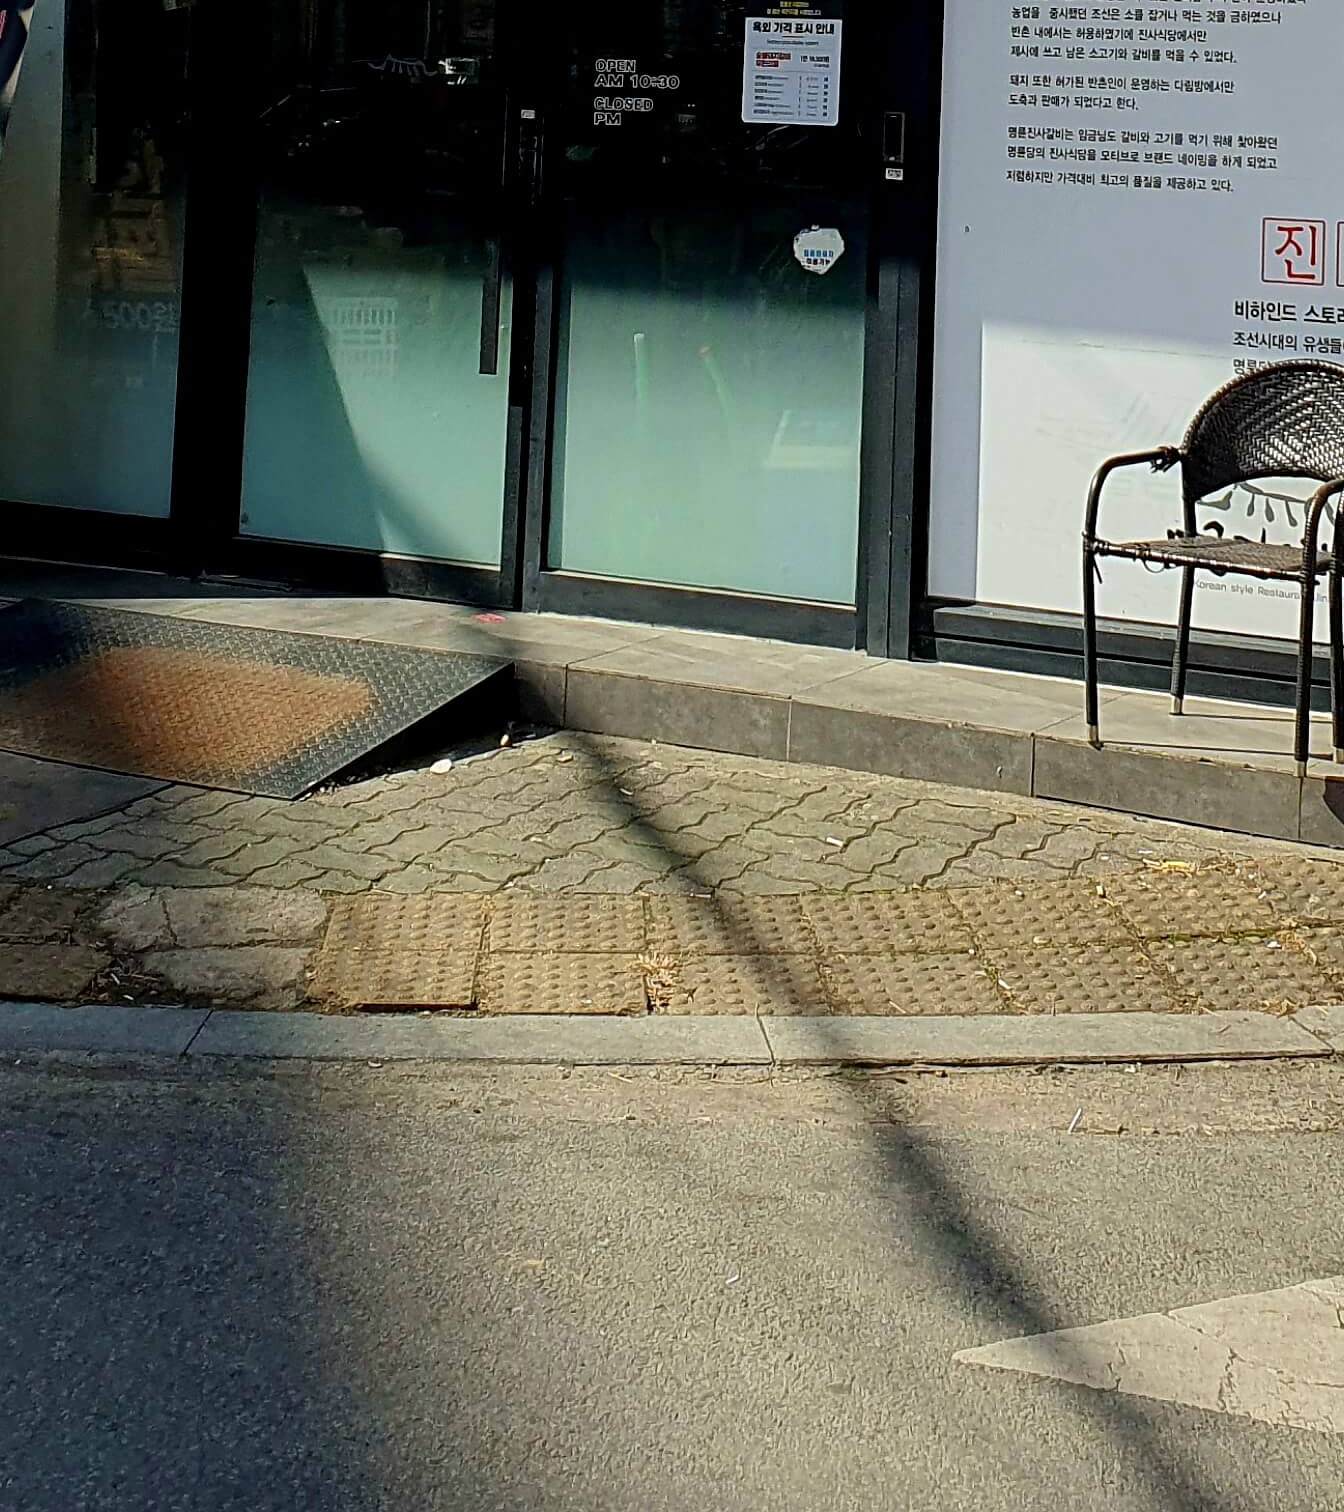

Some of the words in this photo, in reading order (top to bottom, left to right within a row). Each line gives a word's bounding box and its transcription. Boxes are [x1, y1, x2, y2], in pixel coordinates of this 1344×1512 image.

[595, 59, 636, 74] OPEN
[594, 74, 624, 88] AM
[594, 97, 653, 112] CLOSED
[594, 112, 621, 126] PM
[1234, 300, 1297, 322] 비하인드
[1232, 330, 1298, 352] 조선시대의
[1231, 583, 1253, 596] style
